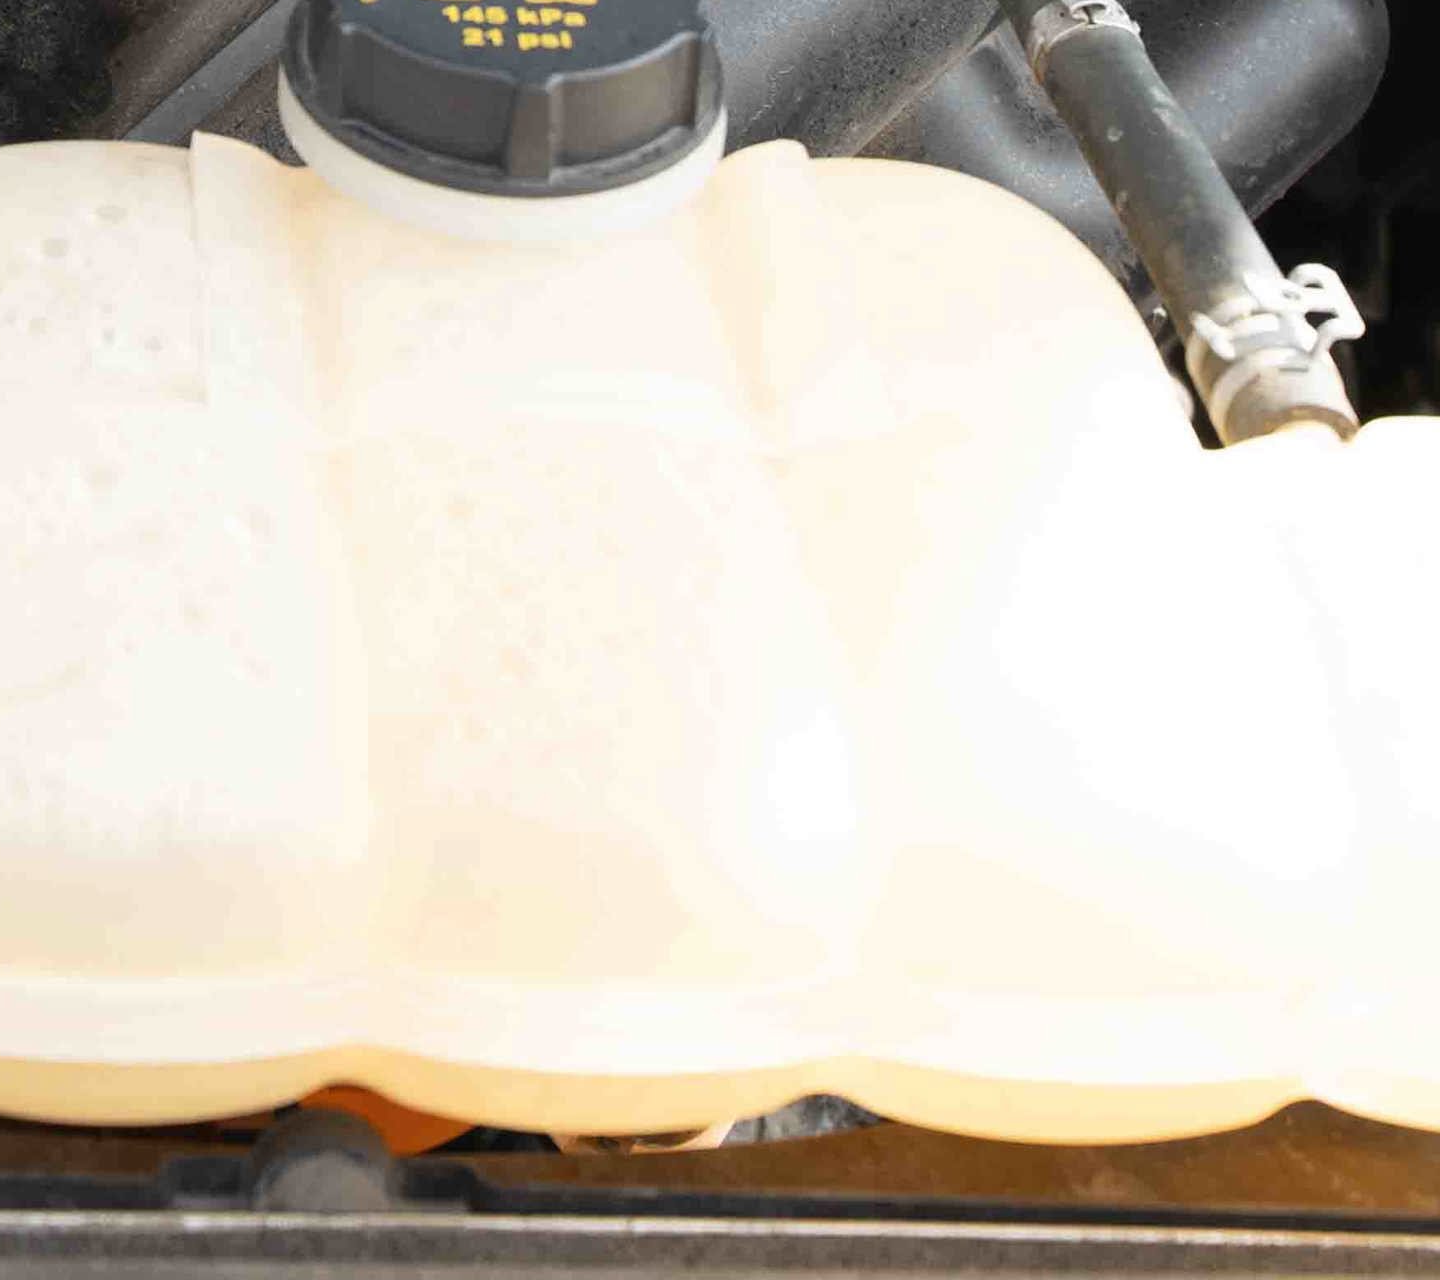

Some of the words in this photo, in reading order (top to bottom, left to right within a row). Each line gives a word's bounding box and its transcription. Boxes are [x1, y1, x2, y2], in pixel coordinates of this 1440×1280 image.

[441, 4, 509, 26] 145
[516, 6, 587, 28] kPa
[462, 26, 505, 48] 21
[517, 29, 573, 52] psi
